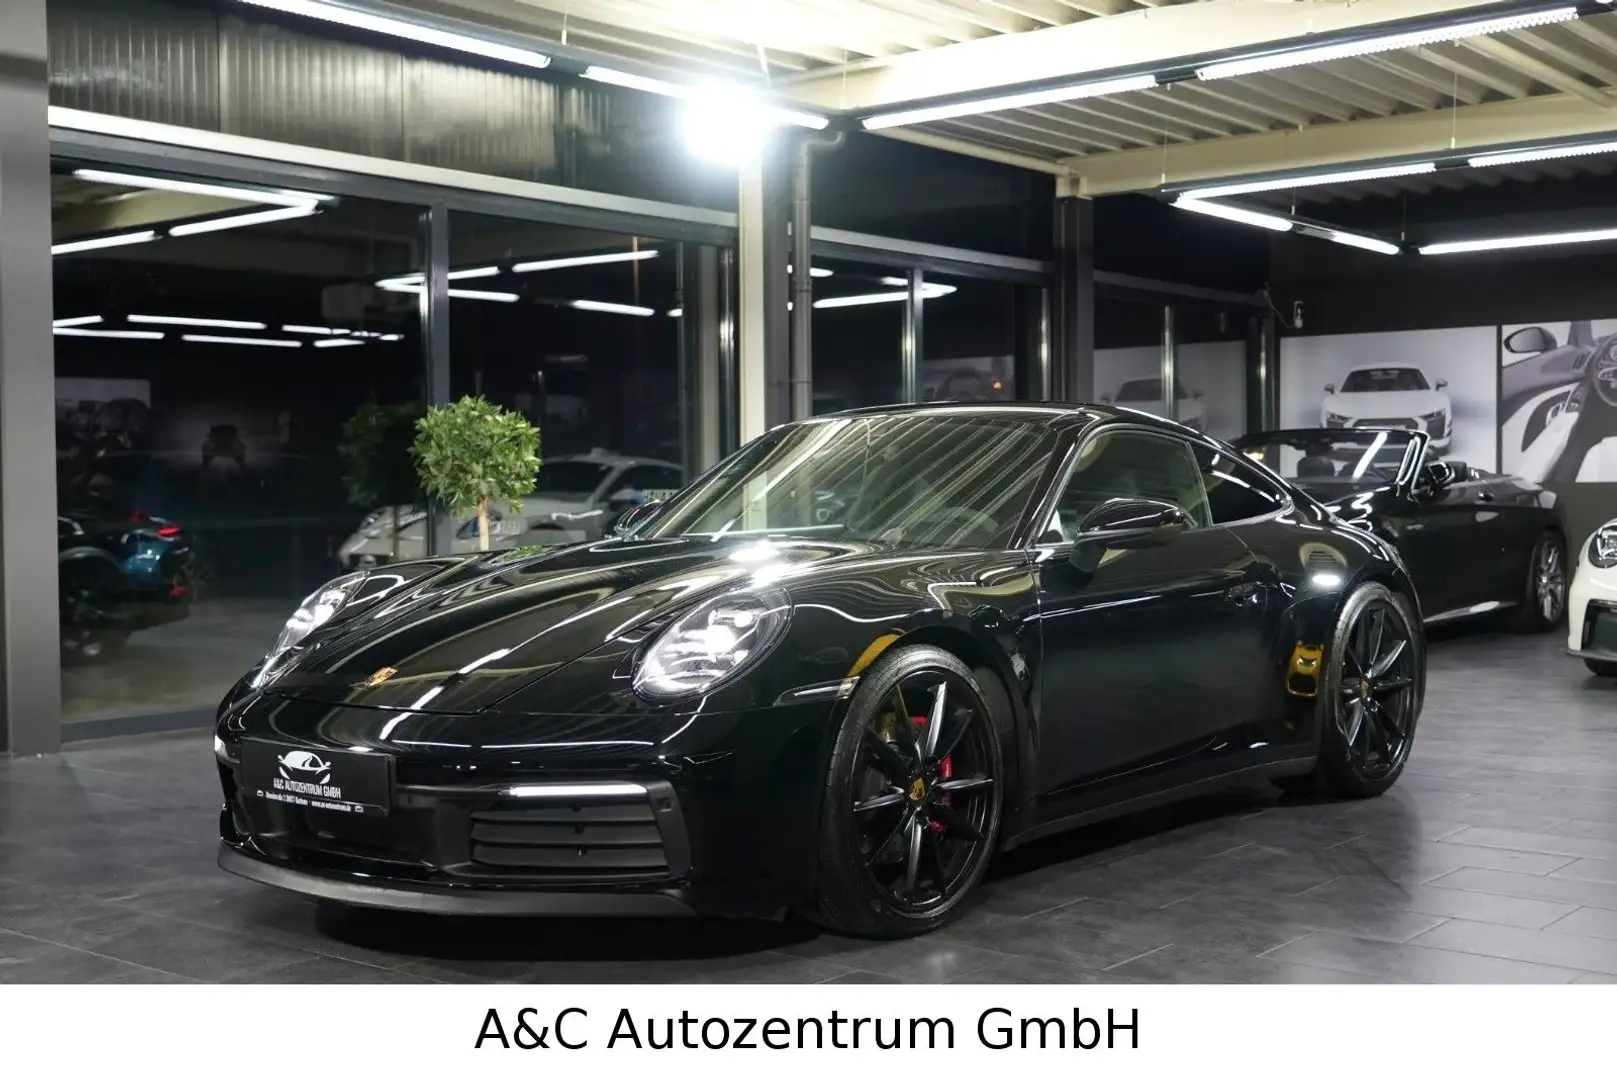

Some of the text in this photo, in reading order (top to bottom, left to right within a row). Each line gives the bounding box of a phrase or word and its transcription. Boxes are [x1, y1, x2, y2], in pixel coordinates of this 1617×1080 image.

[273, 777, 284, 789] A&C
[285, 780, 323, 796] AUTOZENTRUM
[323, 786, 341, 799] GMBH
